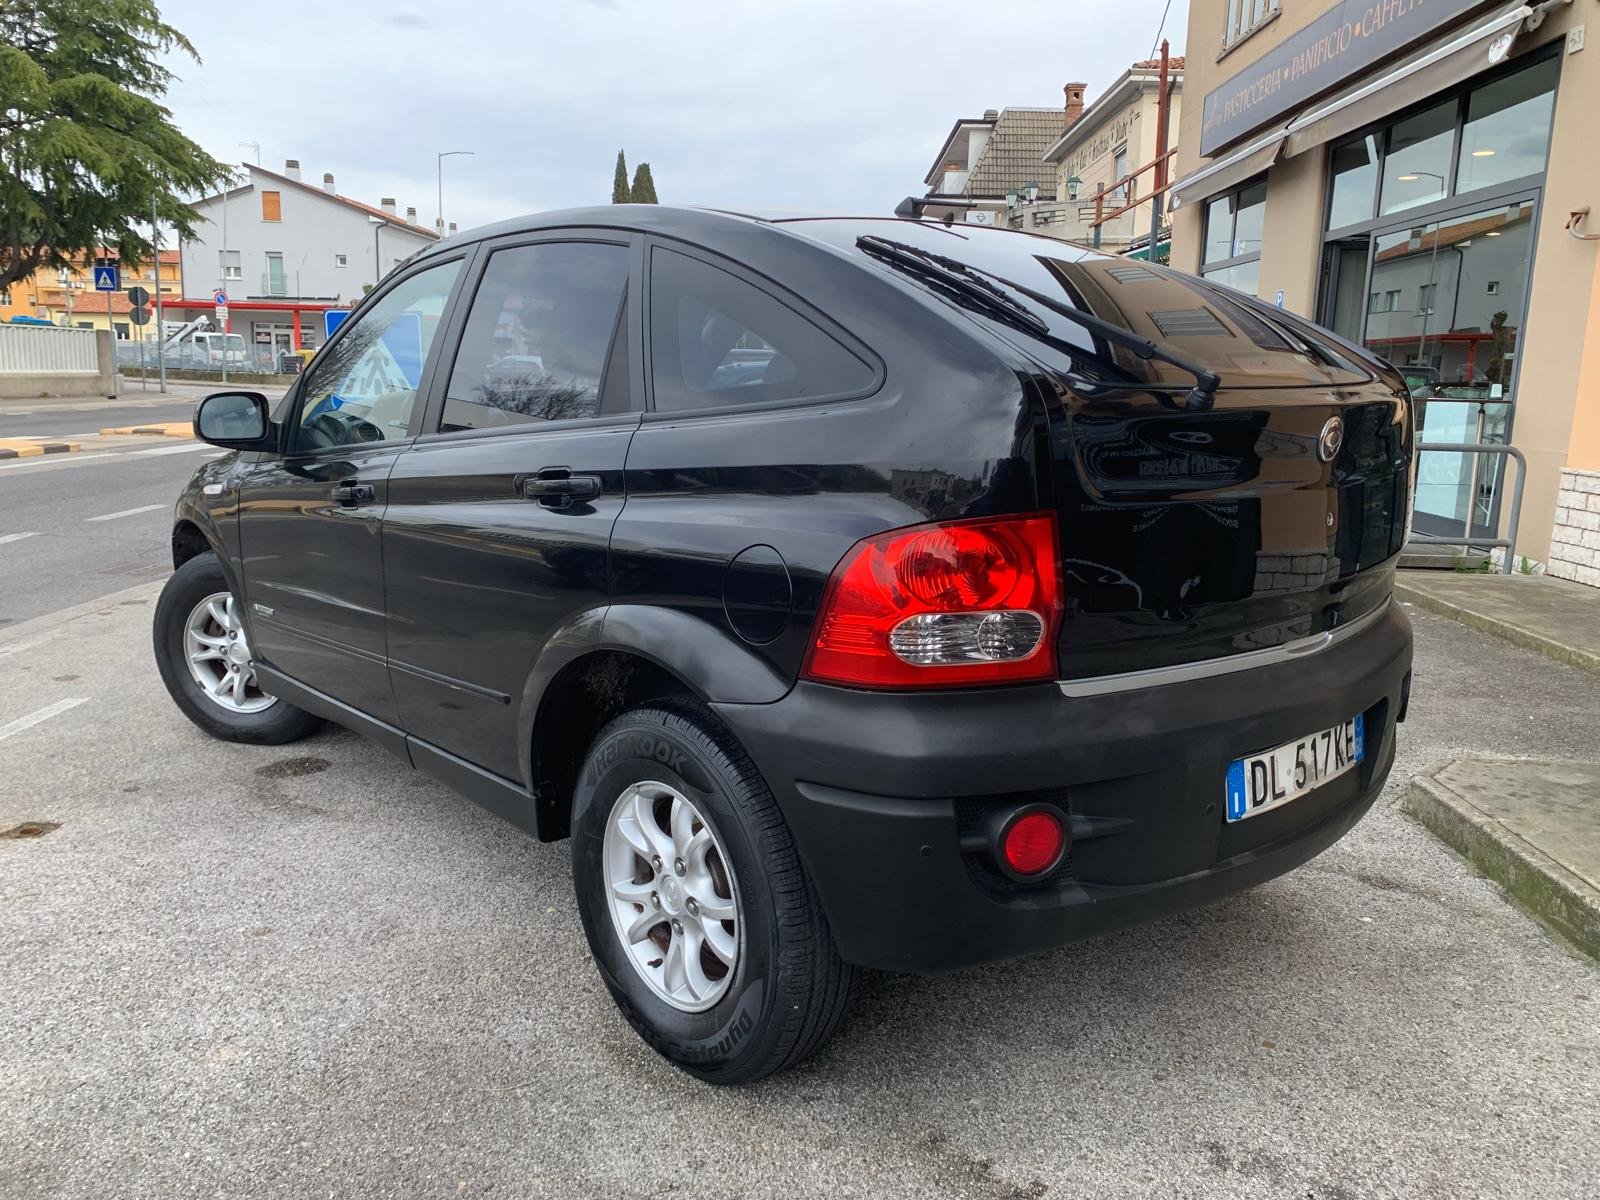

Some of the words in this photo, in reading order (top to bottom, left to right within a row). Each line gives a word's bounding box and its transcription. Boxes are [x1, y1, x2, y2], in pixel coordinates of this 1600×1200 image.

[1223, 68, 1281, 122] PASTICCERIA
[1291, 23, 1352, 81] PANIFICIO
[1362, 0, 1423, 37] CAFFE
[1250, 755, 1285, 808] DL
[1295, 719, 1355, 789] 517KE
